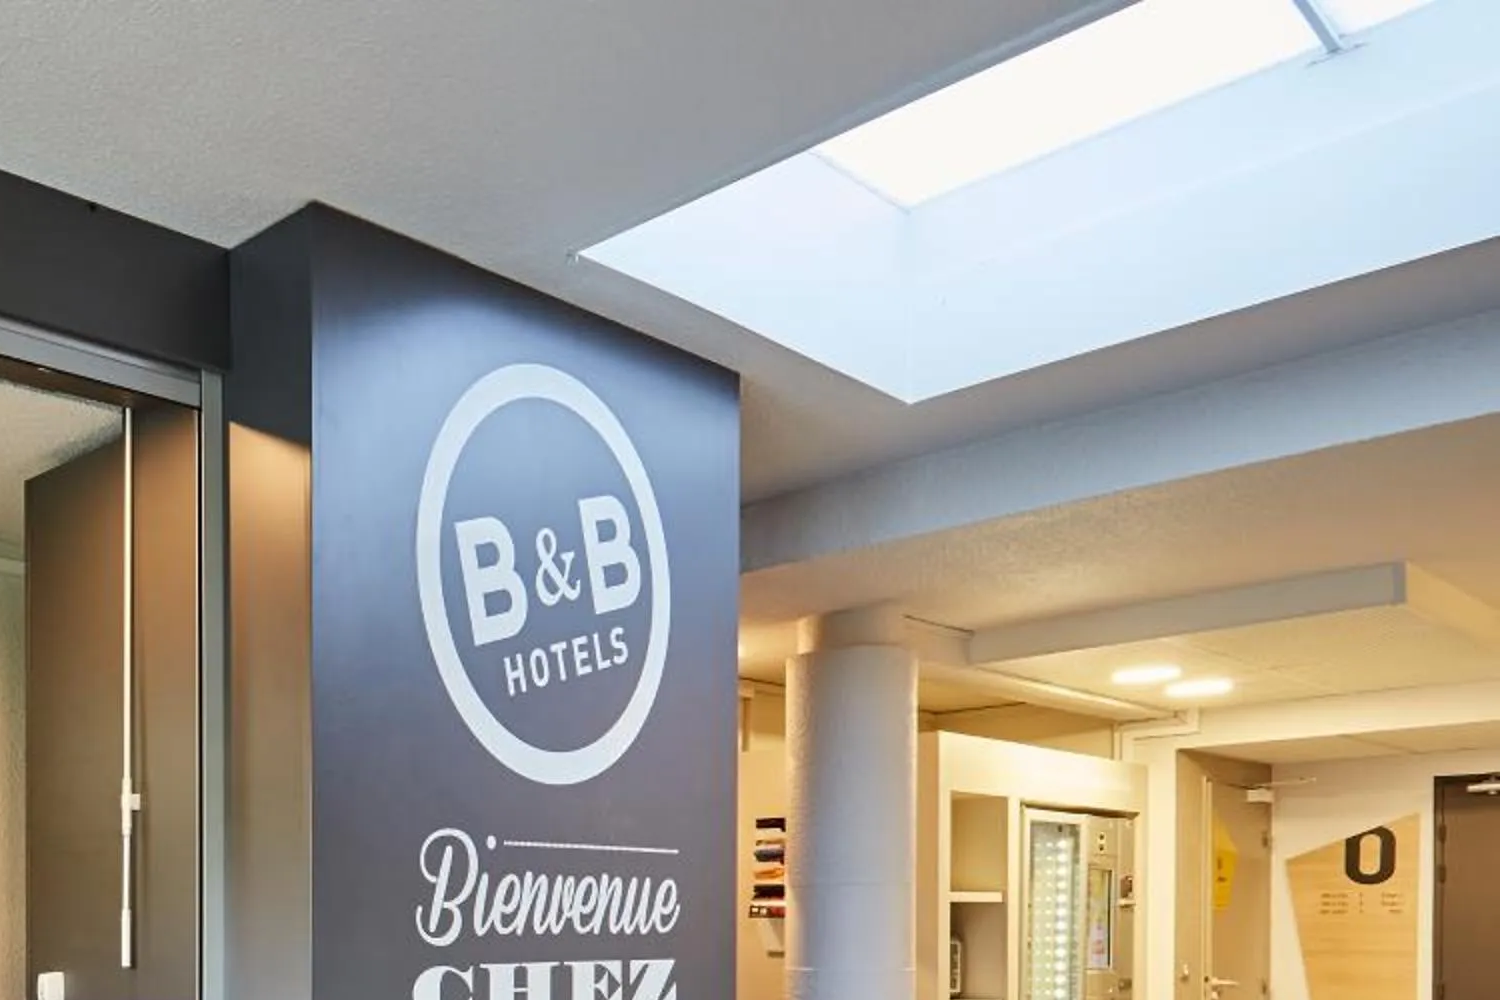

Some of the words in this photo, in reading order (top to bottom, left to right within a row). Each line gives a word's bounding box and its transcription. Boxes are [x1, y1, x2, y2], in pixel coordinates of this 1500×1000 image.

[454, 494, 642, 647] B&B
[503, 626, 630, 697] HOTELS
[414, 827, 682, 948] Bienvenue
